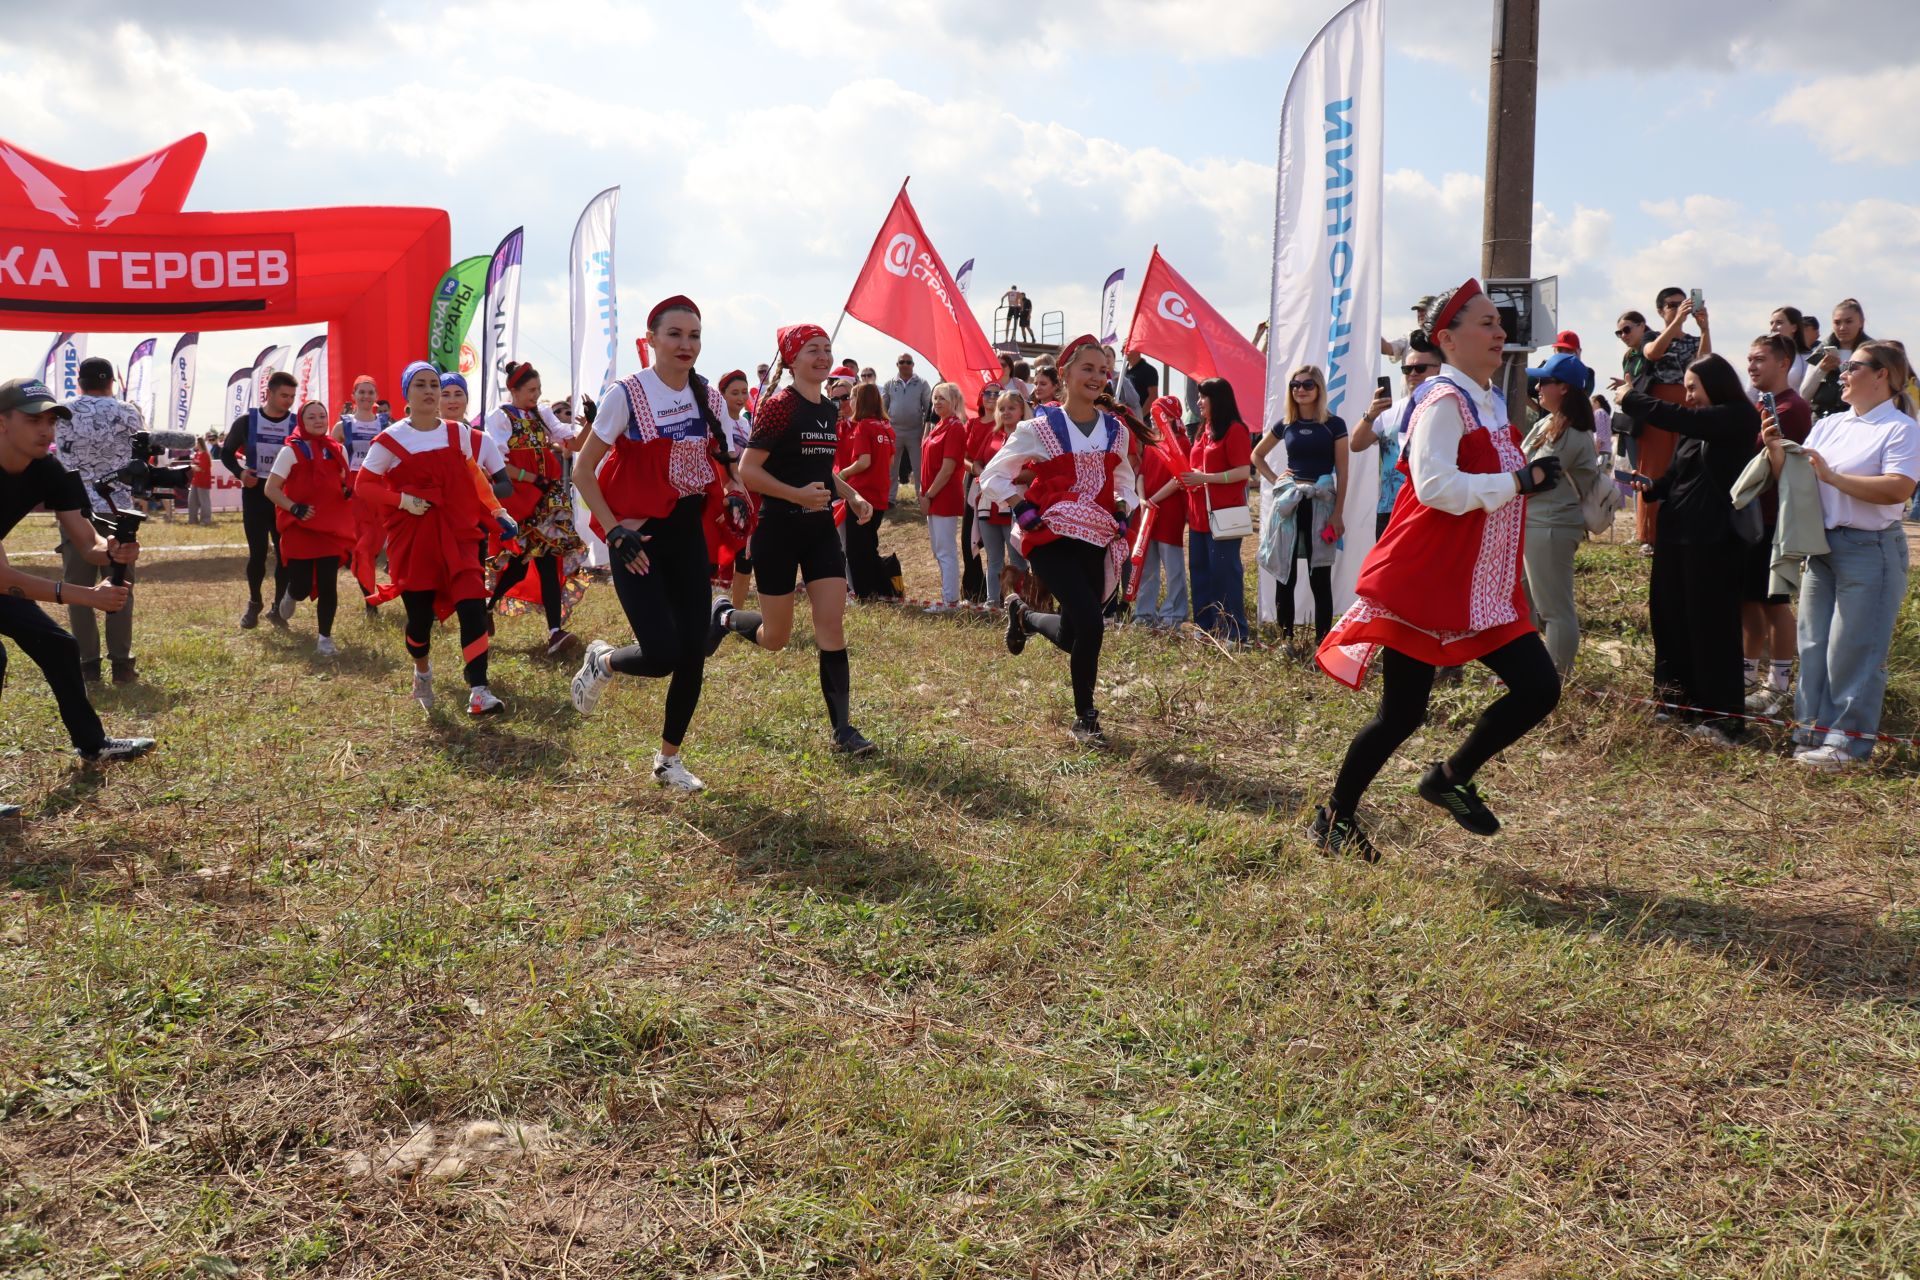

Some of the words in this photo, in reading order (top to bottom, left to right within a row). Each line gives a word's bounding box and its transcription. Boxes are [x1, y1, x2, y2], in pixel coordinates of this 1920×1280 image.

[87, 249, 290, 289] ГЕРОЕВ
[431, 300, 450, 349] ОКНА
[444, 280, 456, 294] РФ
[442, 284, 475, 354] СТРАНЫ
[494, 295, 507, 402] TANK
[657, 407, 678, 416] ГОНКА
[801, 432, 823, 440] ГОНКА
